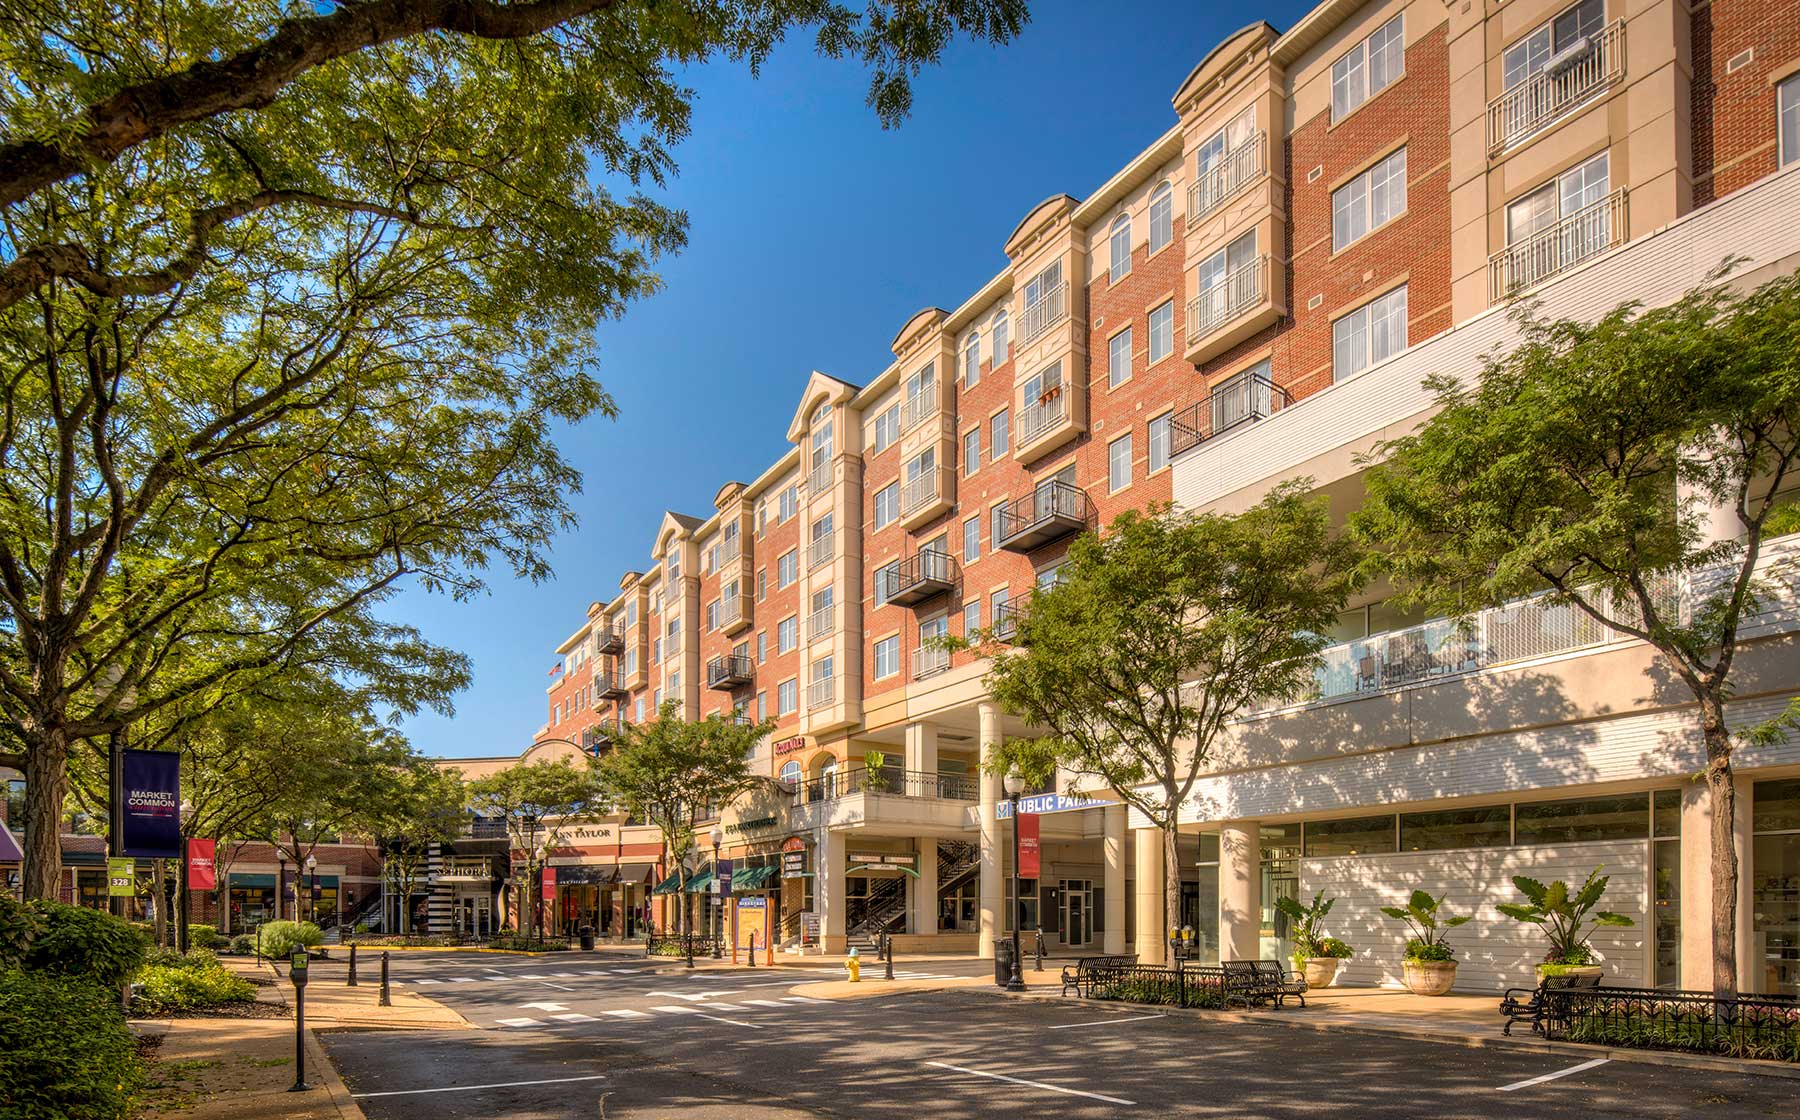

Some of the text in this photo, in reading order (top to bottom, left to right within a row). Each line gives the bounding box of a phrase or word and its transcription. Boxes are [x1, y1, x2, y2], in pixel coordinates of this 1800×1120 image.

[131, 791, 173, 799] MARKET
[128, 799, 175, 807] COMMON
[1016, 797, 1054, 813] UBLIC
[575, 829, 611, 838] TAYLOR
[436, 867, 489, 877] SEPHORA
[112, 878, 129, 886] 328
